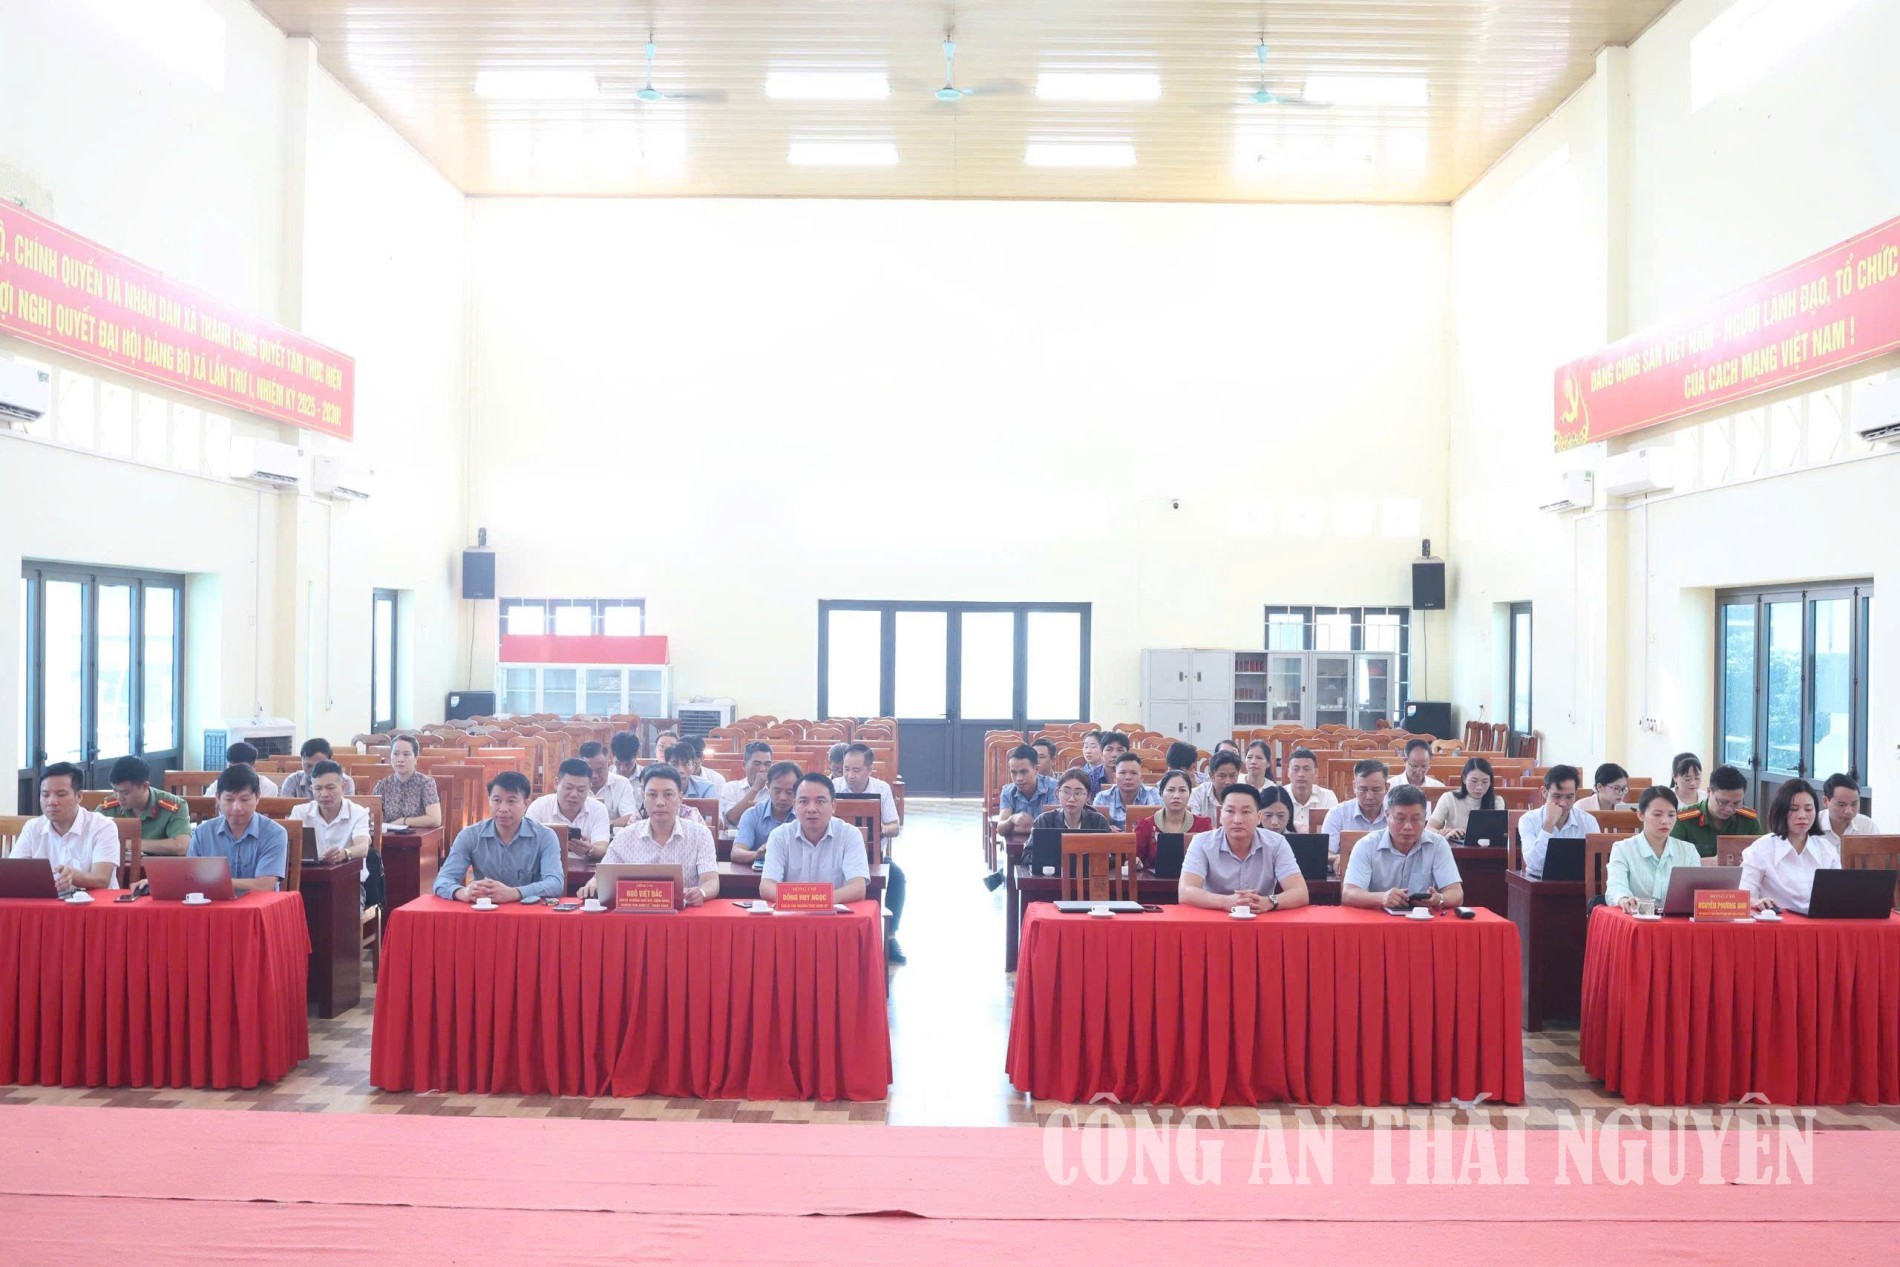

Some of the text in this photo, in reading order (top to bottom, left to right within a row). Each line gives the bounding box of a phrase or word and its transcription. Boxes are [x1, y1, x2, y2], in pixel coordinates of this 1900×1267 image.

[15, 232, 58, 280] CHÍNH
[61, 256, 103, 298] QUYỀN
[1800, 276, 1831, 316] ĐẠO,
[1835, 252, 1854, 299] TỔ
[1857, 243, 1899, 290] CHỨC
[18, 288, 52, 336] NGHỊ
[55, 303, 97, 344] QUYẾT
[99, 321, 119, 358] ĐẠI
[122, 325, 142, 367] HỘI
[144, 331, 174, 371] ĐẢNG
[177, 345, 191, 382] BỘ
[193, 352, 207, 380] XÃ
[209, 353, 228, 389] LẦN
[230, 366, 248, 394] THỨ
[257, 376, 284, 409] NHIỆM
[298, 391, 316, 417] 2025
[1684, 364, 1705, 400] CỦA
[1708, 357, 1739, 392] CÁCH
[1741, 343, 1778, 384] MẠNG
[1781, 329, 1808, 370] VIỆT
[1812, 319, 1846, 358] NAM
